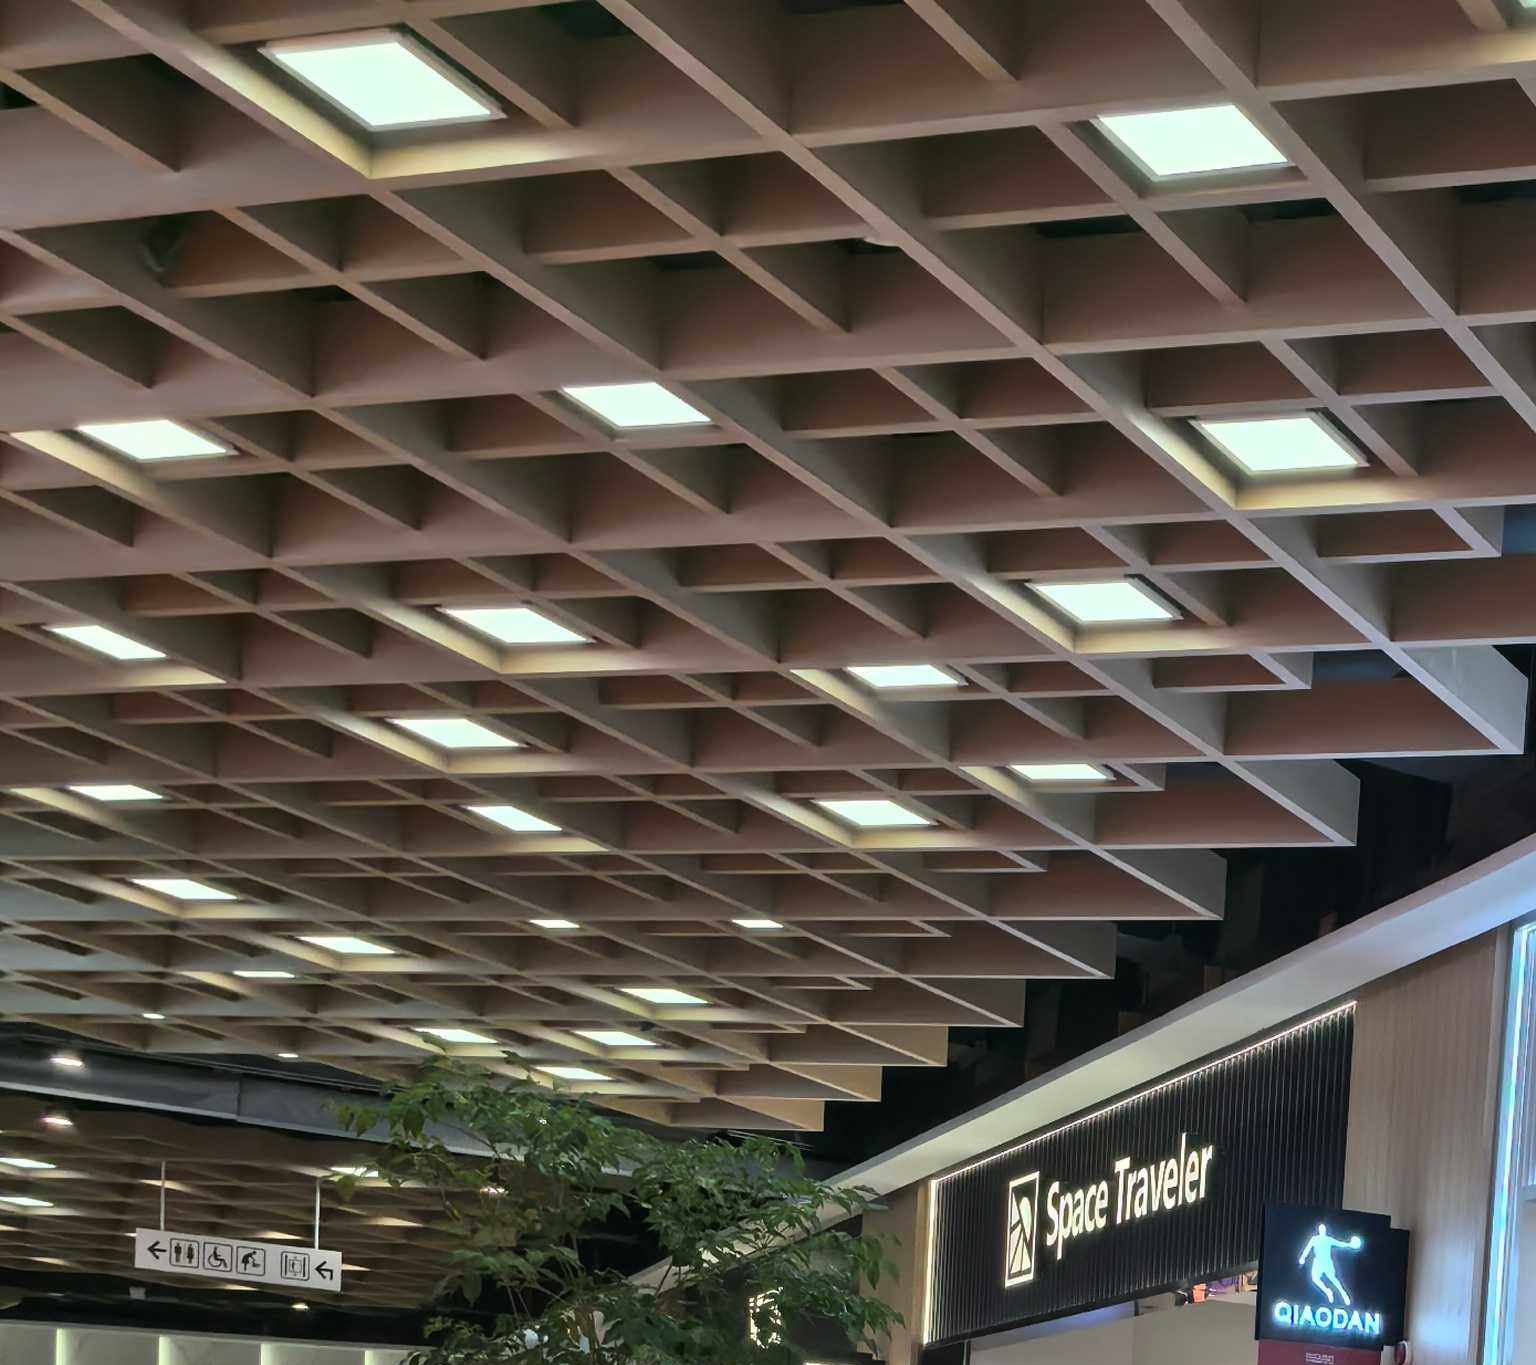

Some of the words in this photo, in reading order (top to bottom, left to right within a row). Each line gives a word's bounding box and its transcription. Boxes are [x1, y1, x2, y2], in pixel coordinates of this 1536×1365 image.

[1046, 1180, 1109, 1260] Space
[1114, 1132, 1213, 1224] Traveler
[1273, 1301, 1381, 1335] QIAODAN
